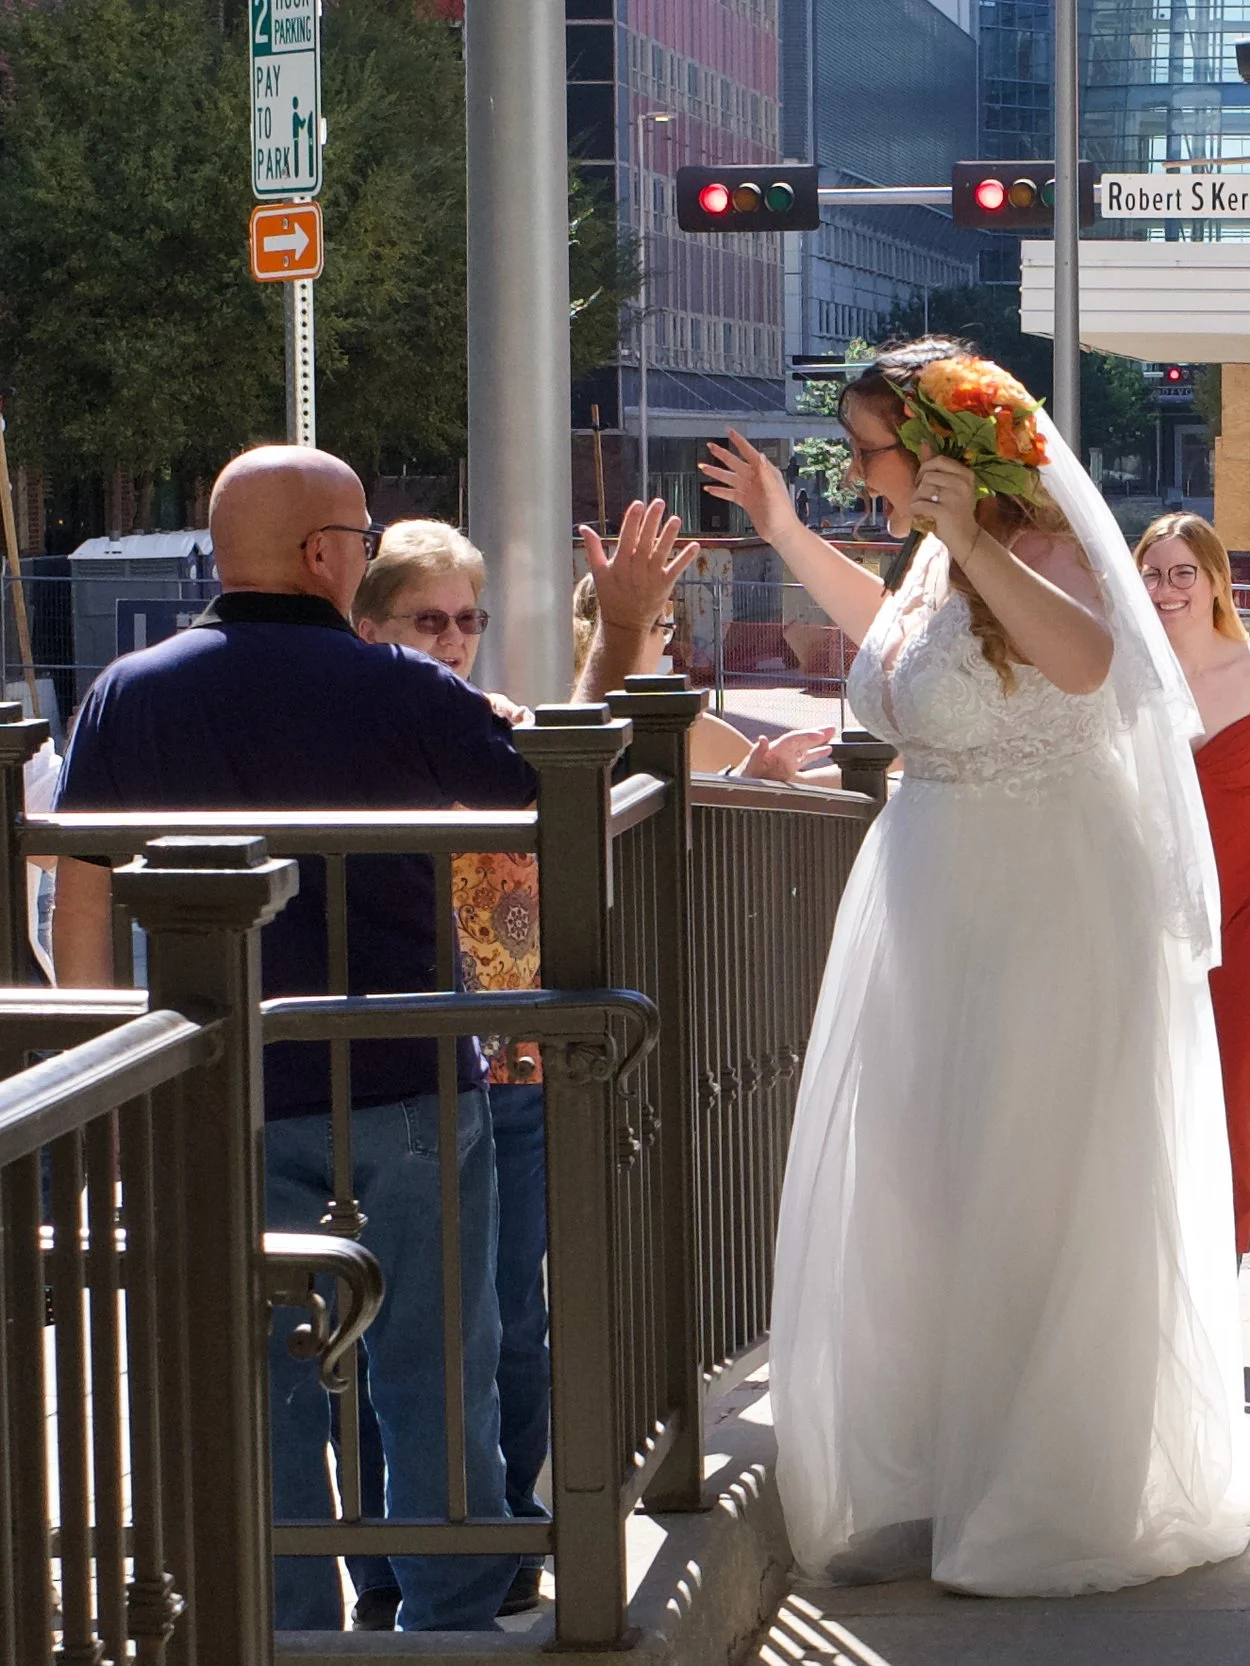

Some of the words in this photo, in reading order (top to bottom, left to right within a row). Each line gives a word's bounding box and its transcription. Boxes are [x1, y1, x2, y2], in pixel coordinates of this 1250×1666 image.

[254, 0, 268, 44] 2
[274, 16, 312, 45] PARKING
[256, 65, 281, 98] PAY
[257, 107, 272, 139] TO
[257, 147, 291, 180] PARK
[1108, 182, 1182, 211] Robert
[1191, 182, 1204, 211] S
